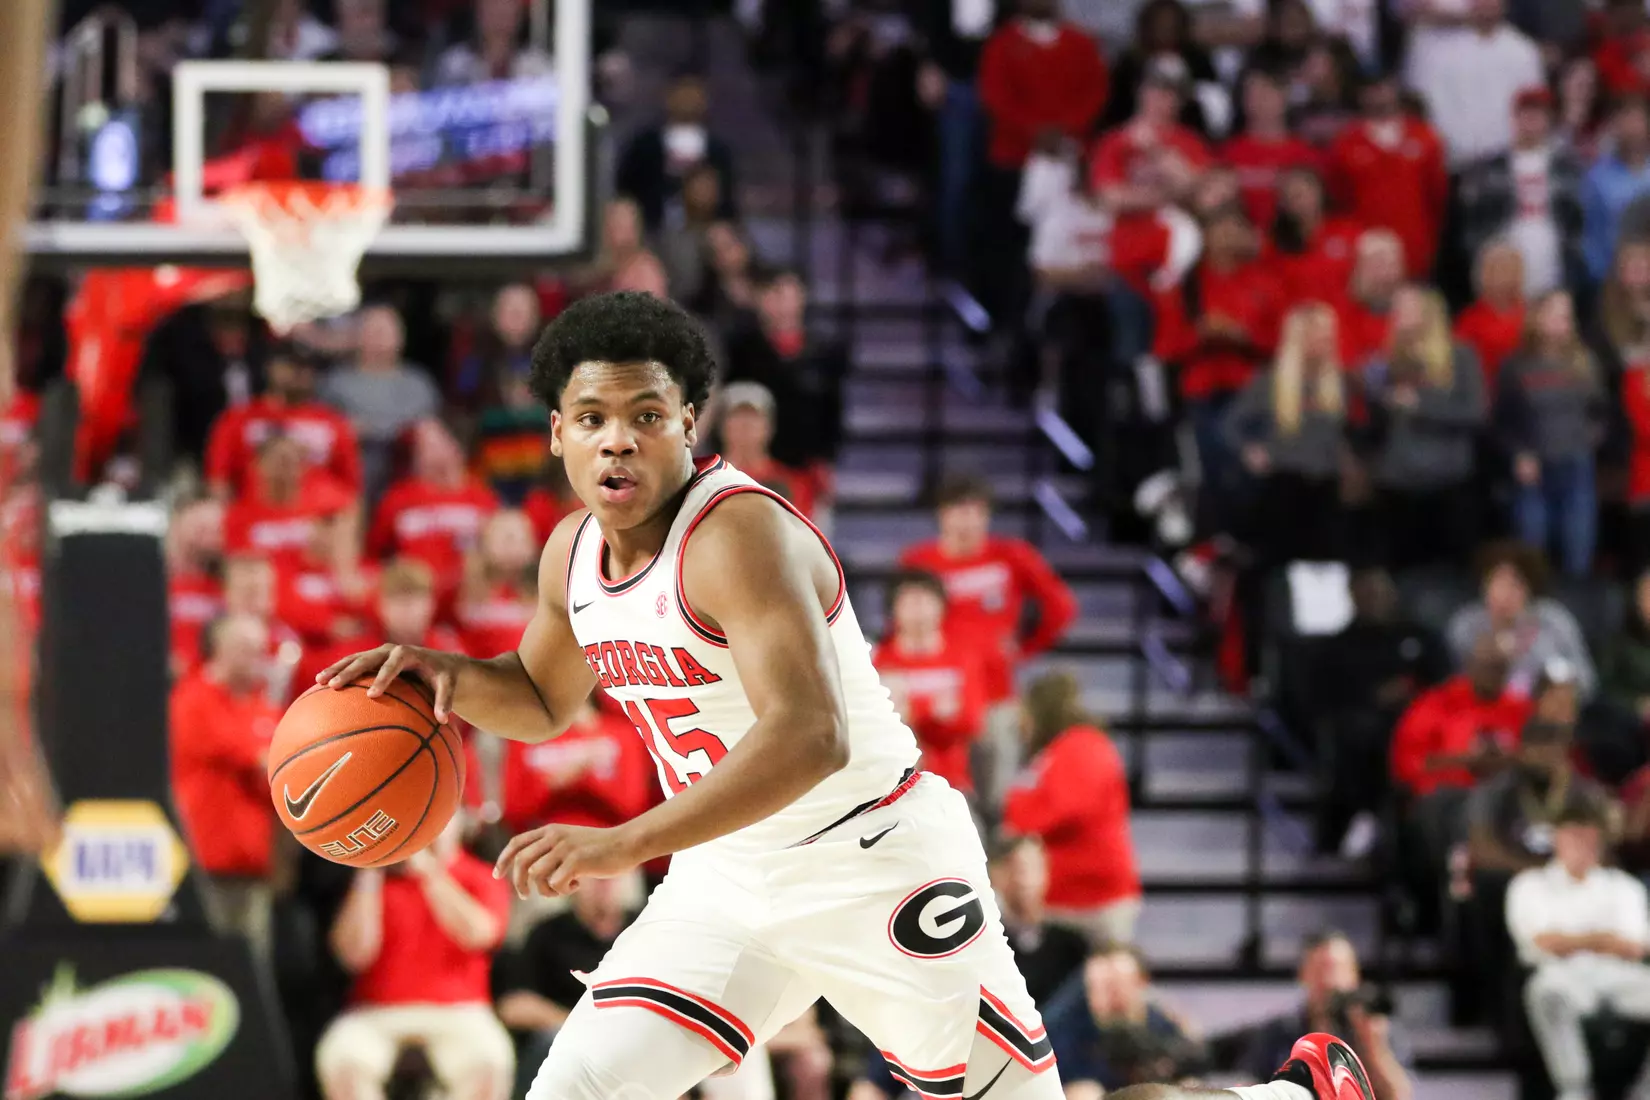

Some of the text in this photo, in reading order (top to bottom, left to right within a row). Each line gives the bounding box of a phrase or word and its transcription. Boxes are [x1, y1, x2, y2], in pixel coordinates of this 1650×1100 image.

[580, 639, 722, 688] EORGIA
[625, 697, 729, 794] 15
[319, 809, 396, 857] ELITE
[892, 881, 985, 955] G
